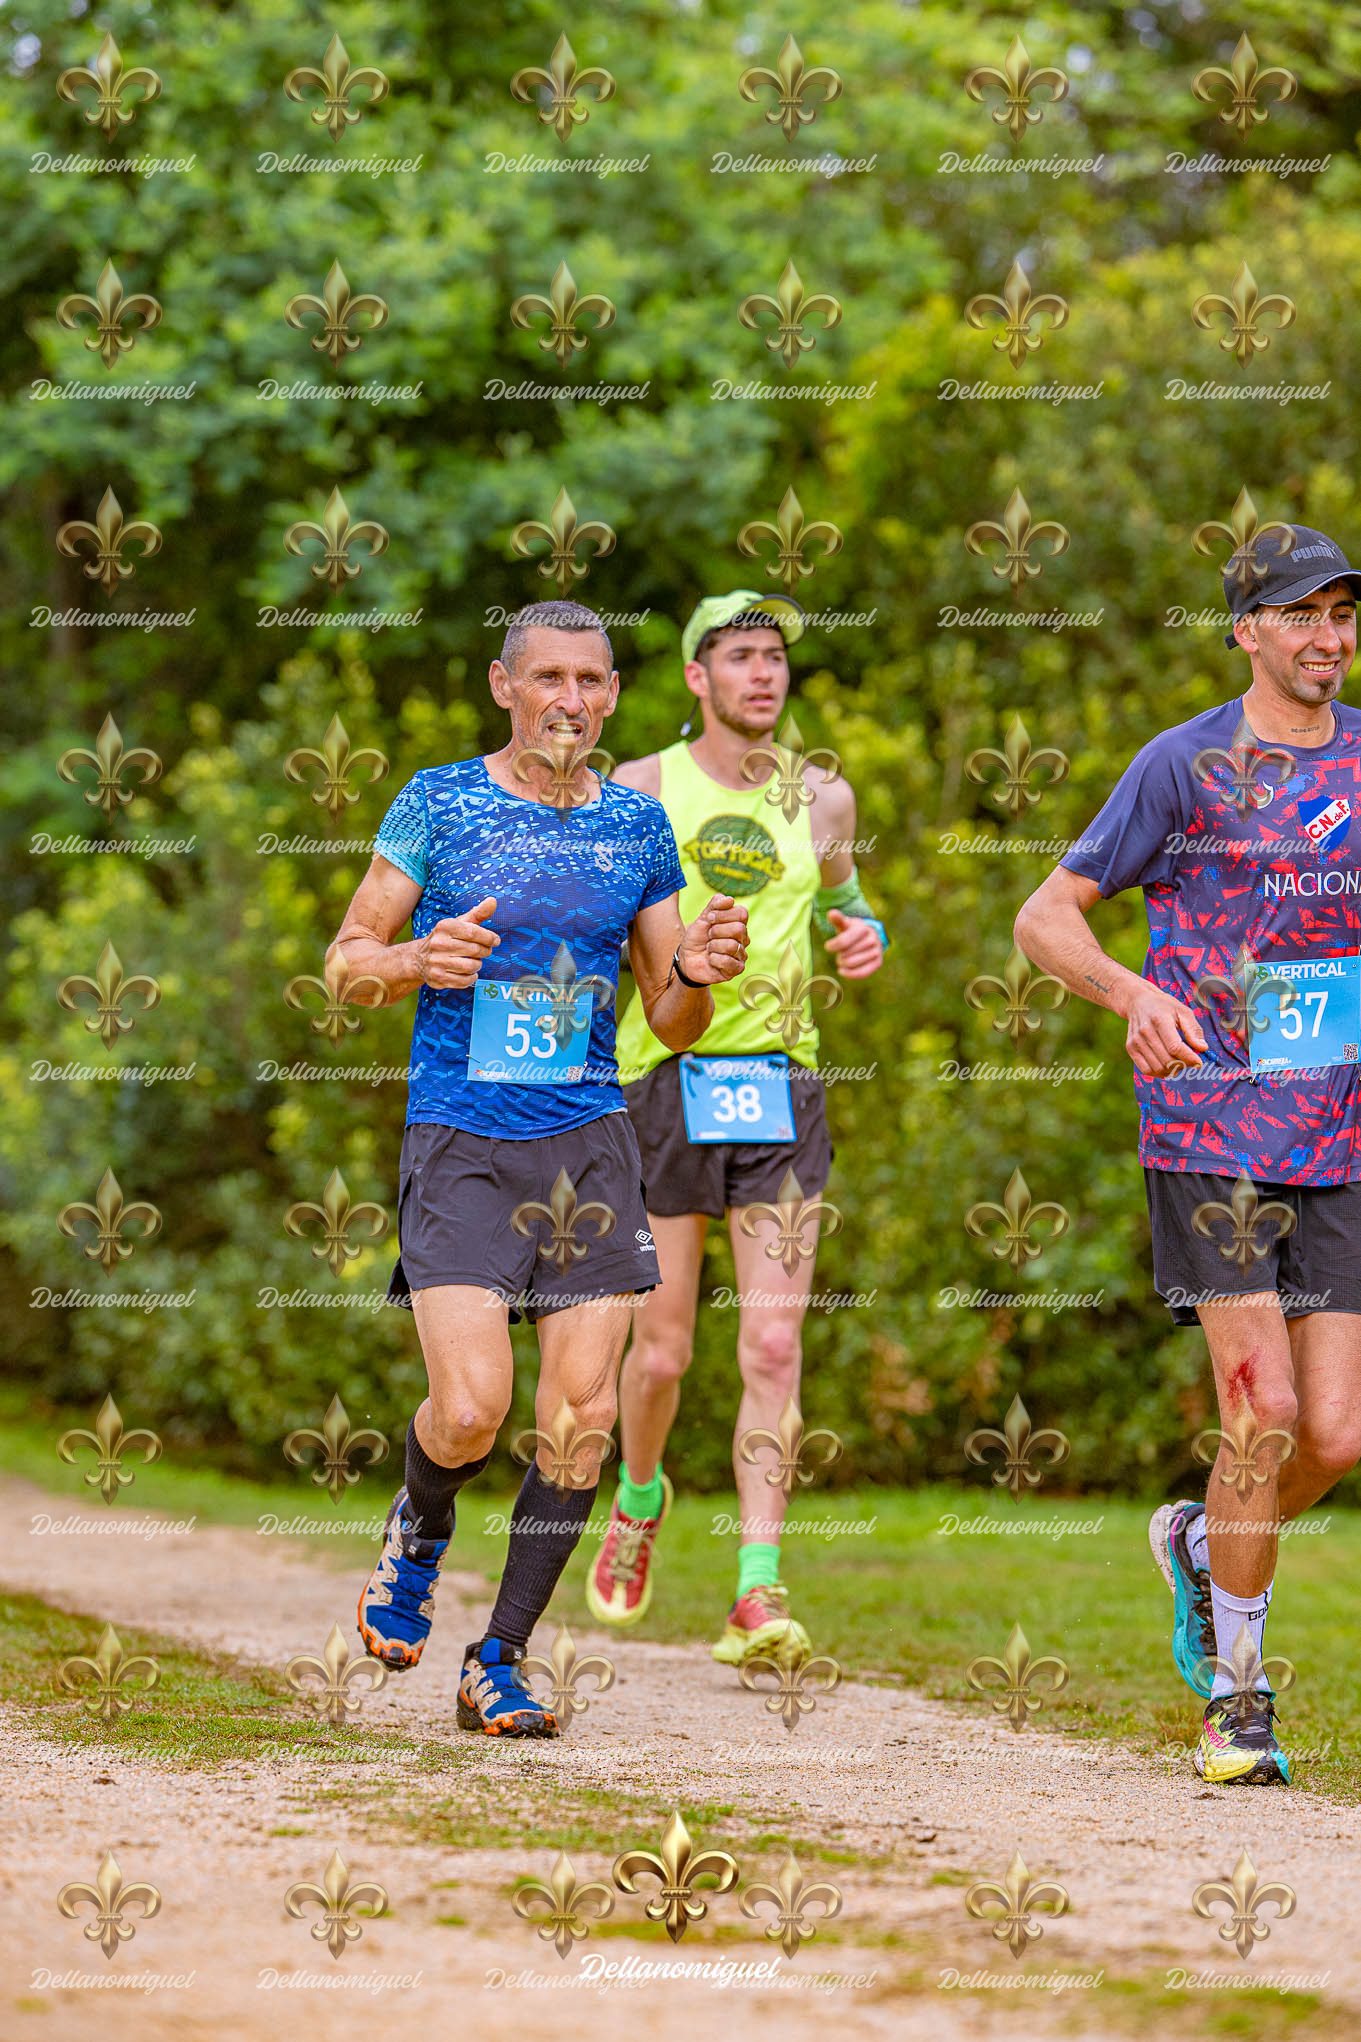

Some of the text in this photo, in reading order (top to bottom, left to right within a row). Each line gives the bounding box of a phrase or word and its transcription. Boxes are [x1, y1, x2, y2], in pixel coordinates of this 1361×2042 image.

[1264, 870, 1361, 896] NACION
[1269, 961, 1347, 980] VERTICAL
[1280, 990, 1328, 1040] 57
[504, 1013, 557, 1059] 53
[711, 1084, 763, 1123] 38
